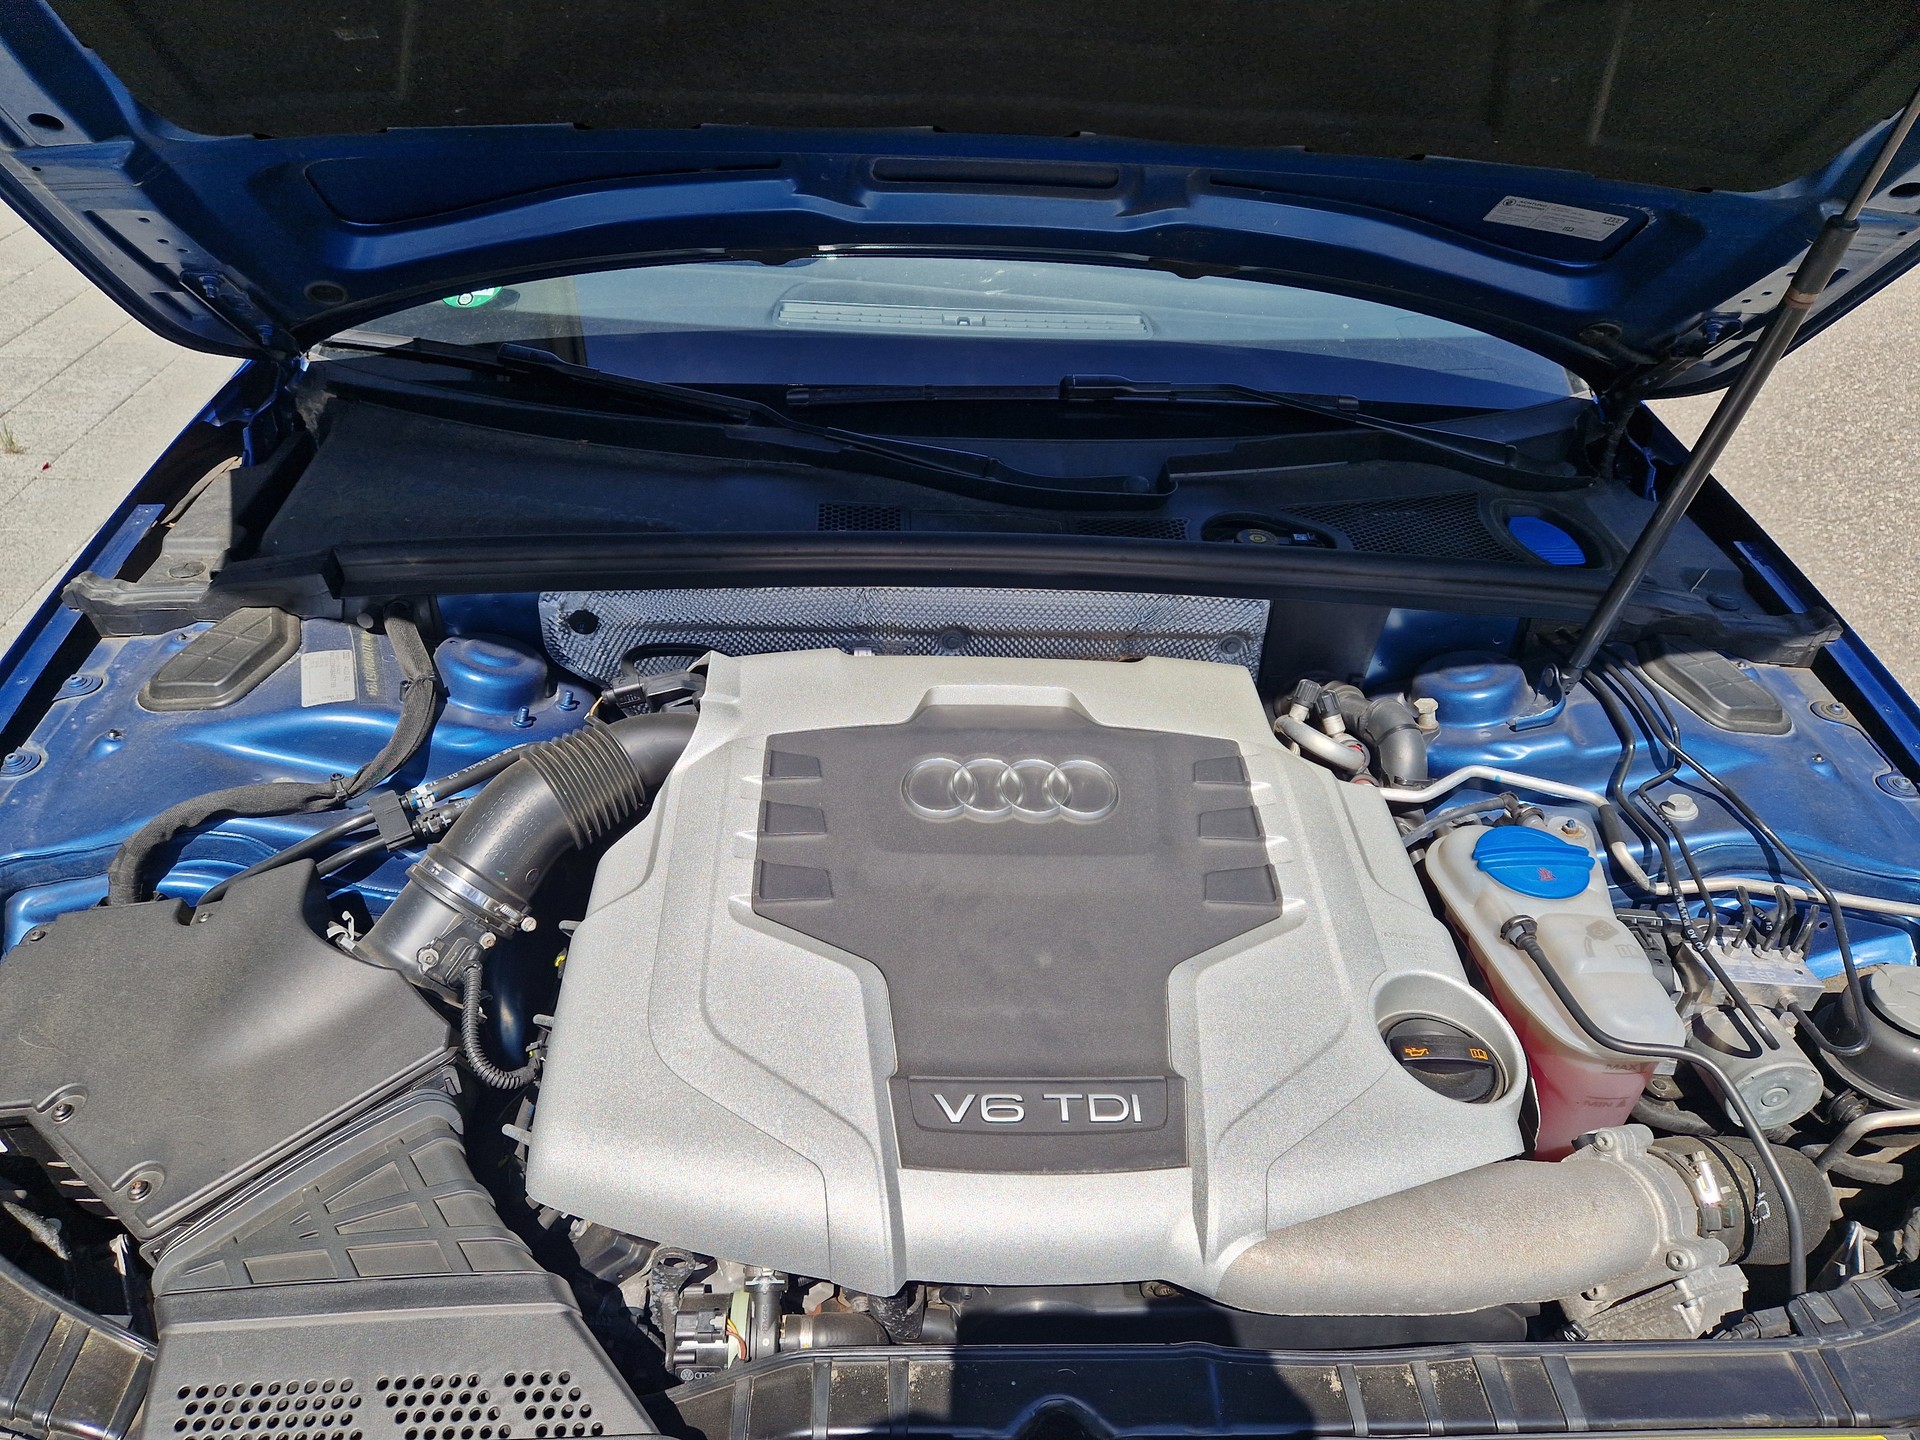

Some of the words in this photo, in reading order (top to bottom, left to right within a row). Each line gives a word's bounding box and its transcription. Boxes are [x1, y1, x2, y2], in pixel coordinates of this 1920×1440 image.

[1604, 1063, 1638, 1071] MAX
[931, 1093, 1026, 1123] V6
[1043, 1093, 1142, 1123] TDI
[1584, 1099, 1612, 1108] MIN
